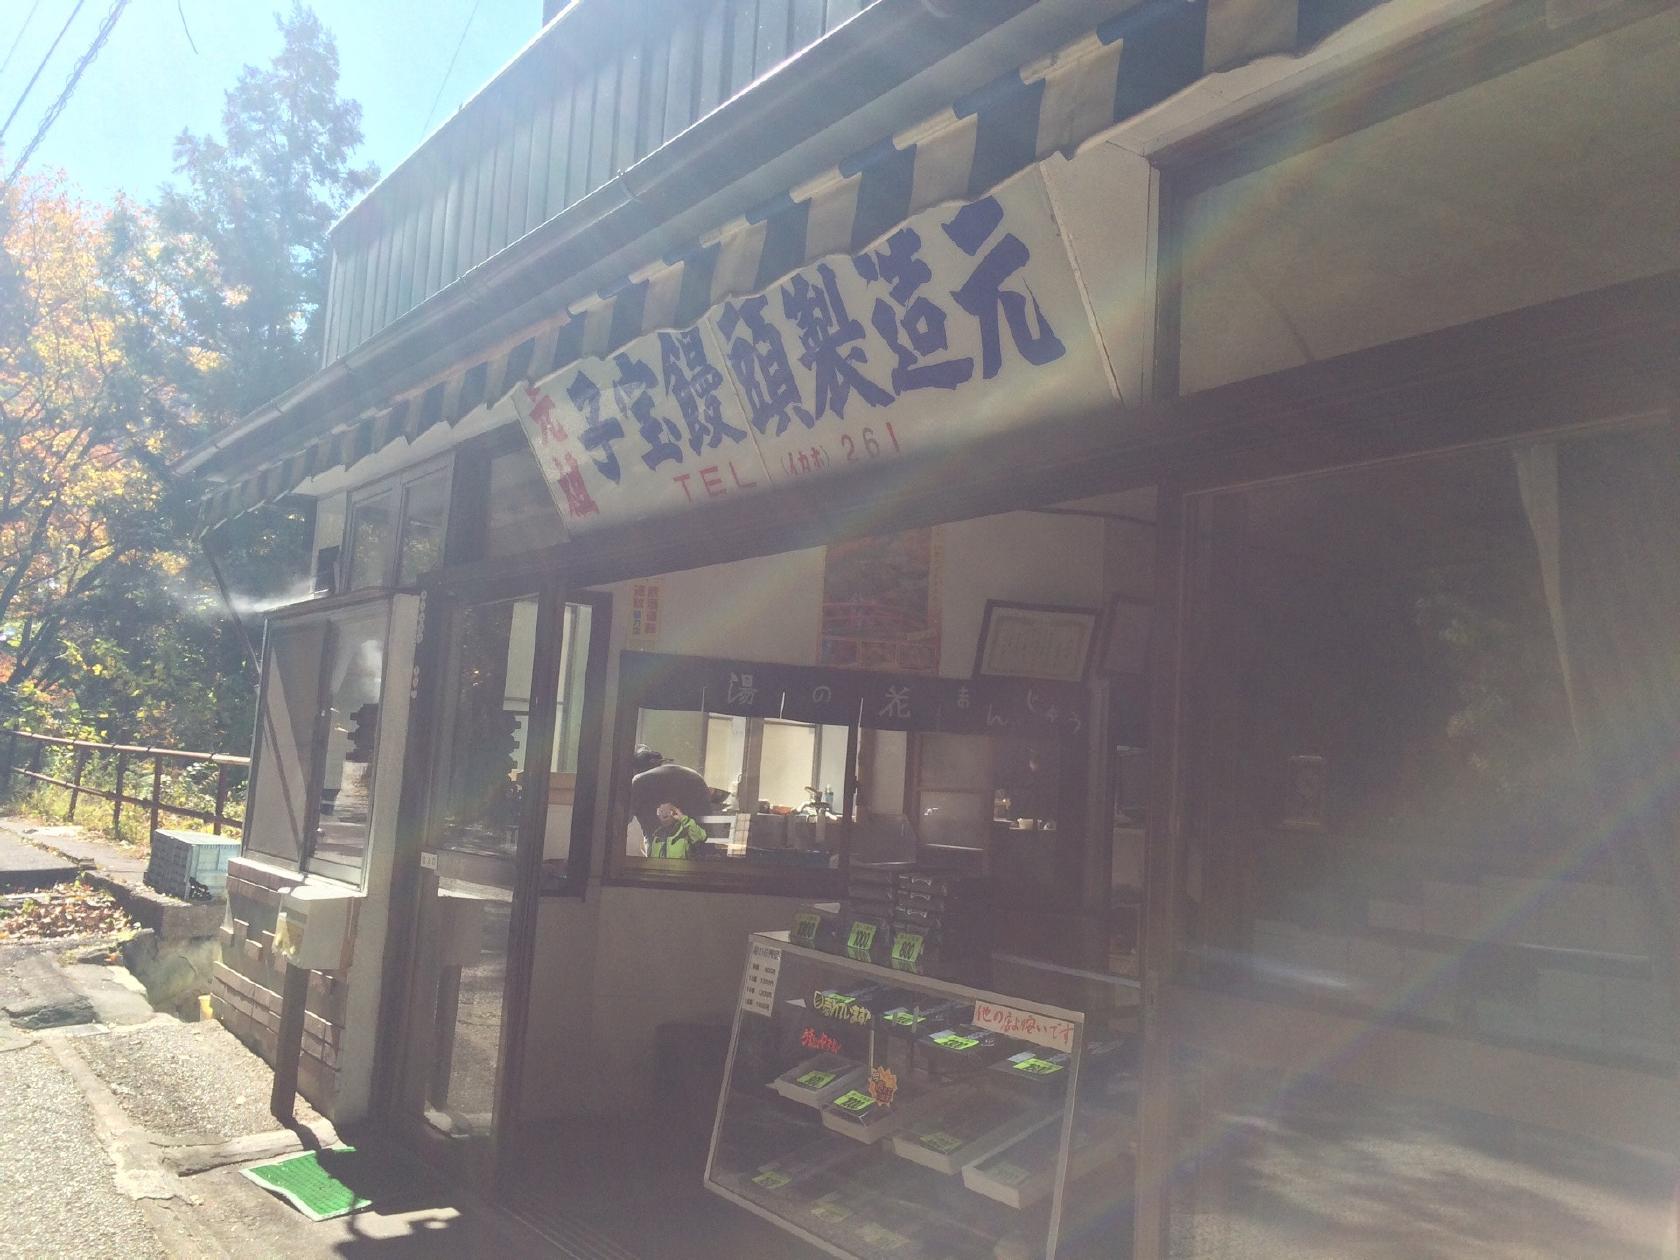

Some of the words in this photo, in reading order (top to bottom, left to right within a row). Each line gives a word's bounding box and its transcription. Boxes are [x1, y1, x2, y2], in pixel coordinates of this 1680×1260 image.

[567, 194, 1067, 485] 子宝饅頭製造元
[672, 460, 757, 504] TEL
[840, 421, 902, 463] 261
